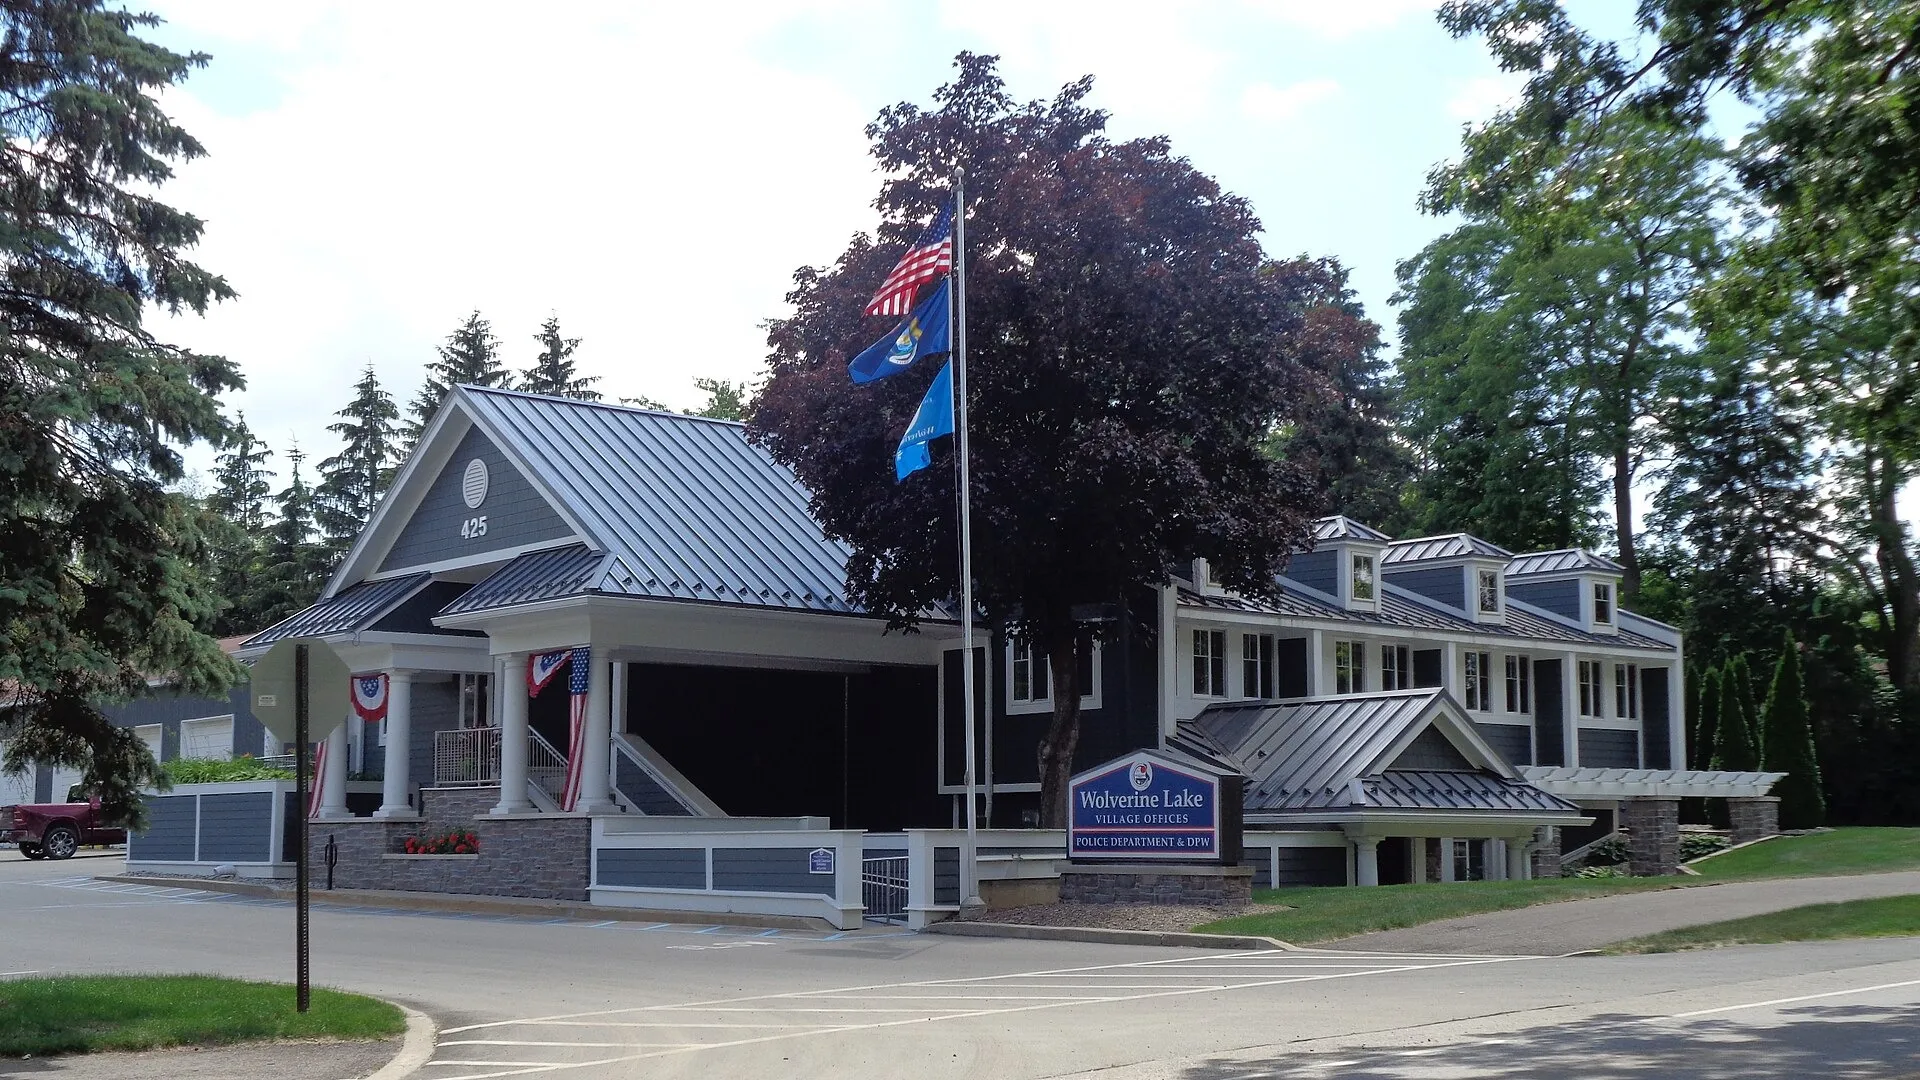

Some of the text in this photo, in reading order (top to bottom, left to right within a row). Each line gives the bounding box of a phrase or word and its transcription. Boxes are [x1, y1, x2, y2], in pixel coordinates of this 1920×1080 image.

[461, 515, 488, 540] 425
[1080, 788, 1203, 809] Wolverine Lake
[1095, 813, 1189, 824] VILLAGE OFFICES
[1076, 837, 1210, 847] POLICE DEPARTMENT & DPW
